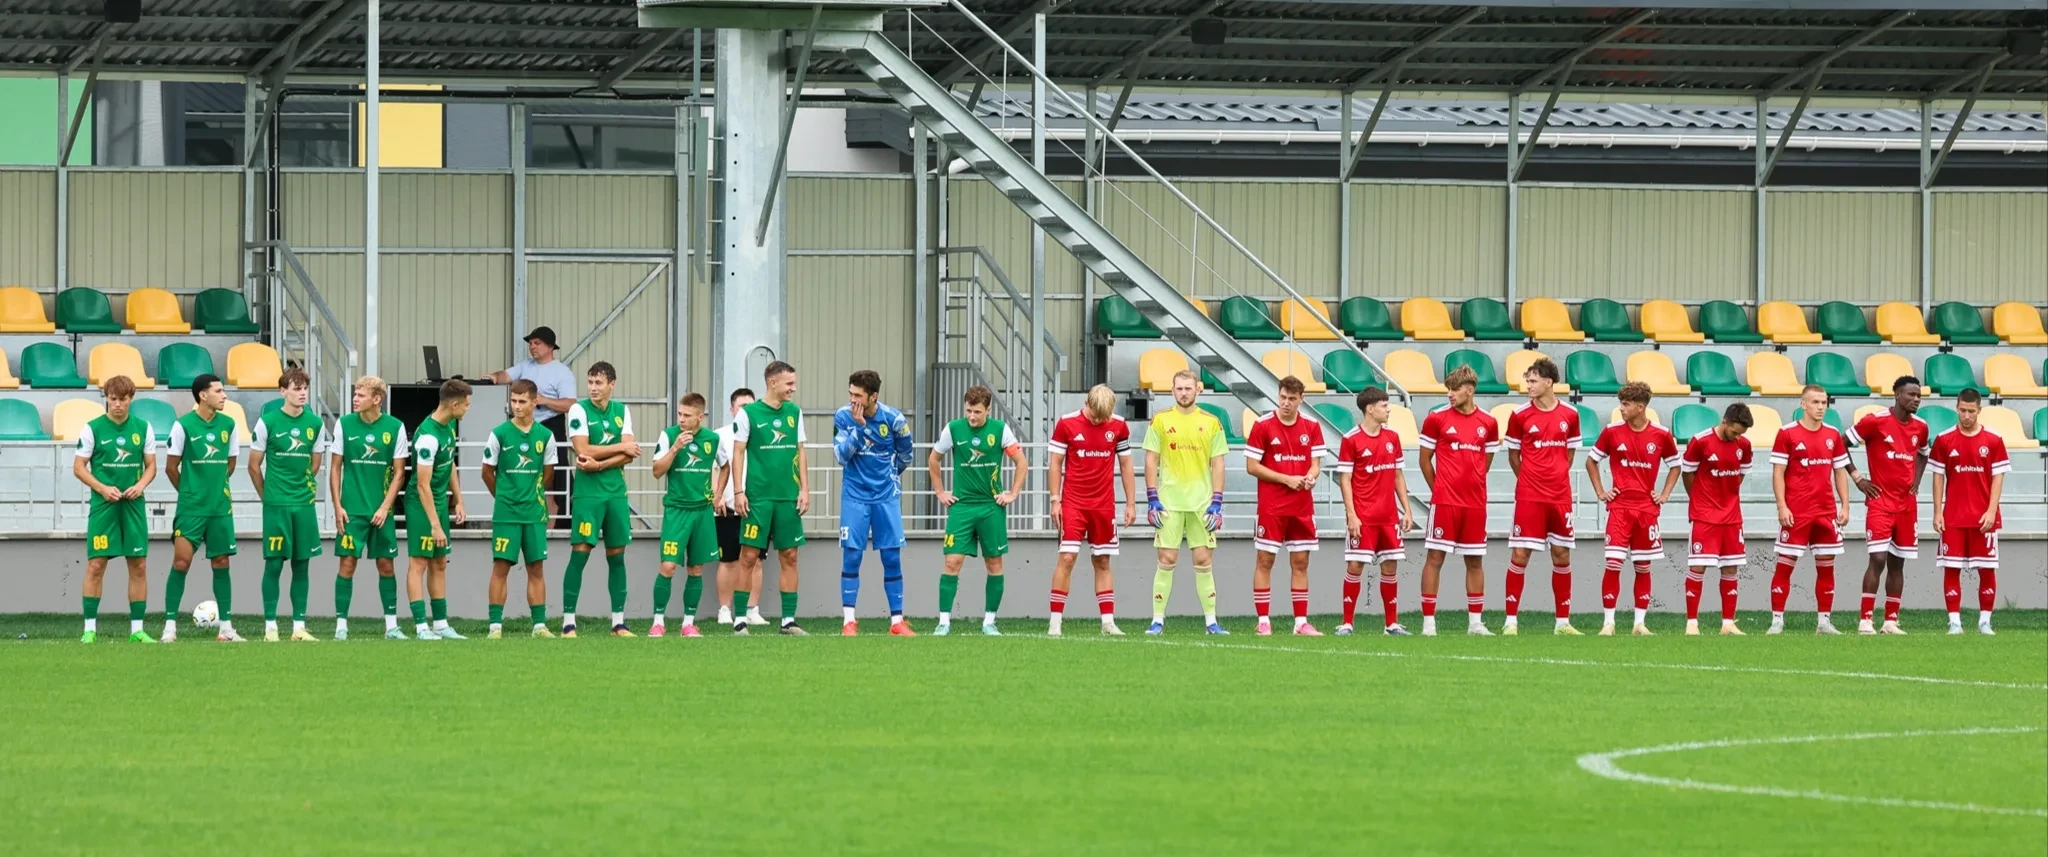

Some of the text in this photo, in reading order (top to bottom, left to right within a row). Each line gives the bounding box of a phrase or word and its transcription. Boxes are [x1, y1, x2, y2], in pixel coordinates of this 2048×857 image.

[1719, 469, 1741, 477] whitebi
[1565, 512, 1573, 528] 2
[579, 521, 592, 536] 48
[744, 524, 758, 539] 16
[269, 536, 283, 551] 77
[341, 535, 354, 549] 41
[420, 536, 433, 551] 75
[495, 537, 509, 552] 37
[663, 541, 678, 555] 55
